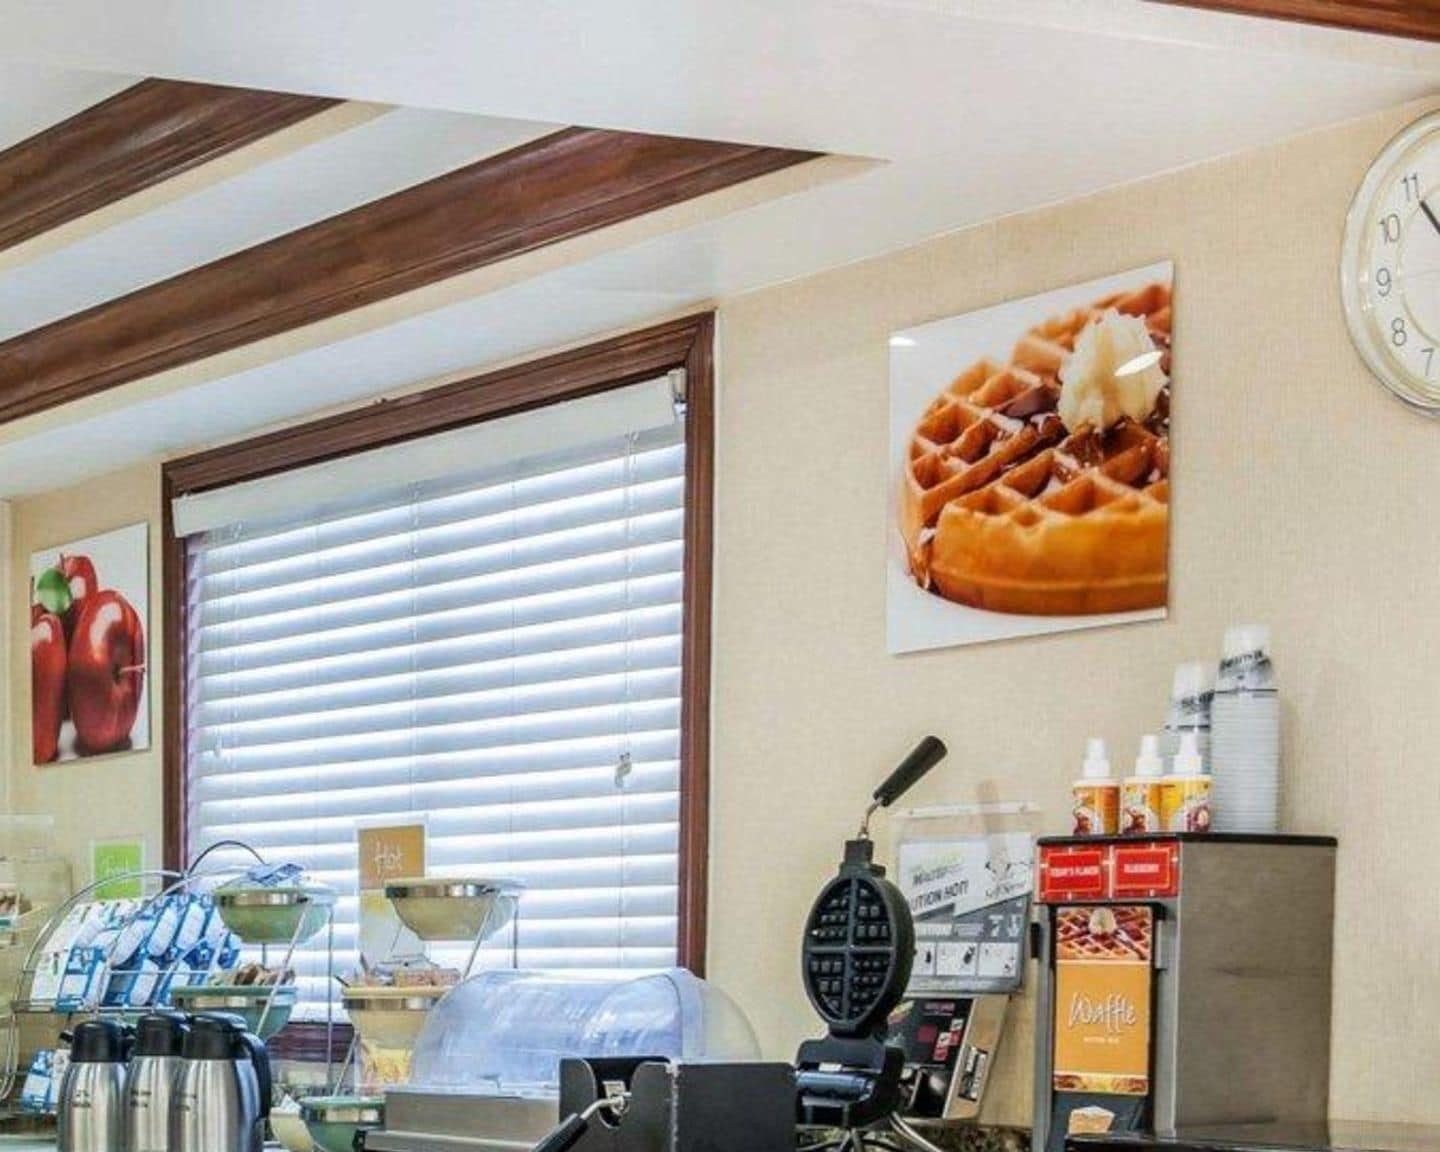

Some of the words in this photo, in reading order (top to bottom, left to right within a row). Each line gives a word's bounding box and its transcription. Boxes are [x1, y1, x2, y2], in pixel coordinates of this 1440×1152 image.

[1401, 172, 1420, 202] 11
[1379, 213, 1401, 246] 10
[1376, 267, 1392, 297] 9
[1391, 317, 1407, 347] 8
[1420, 347, 1435, 376] 7
[1067, 991, 1137, 1033] Waffle
